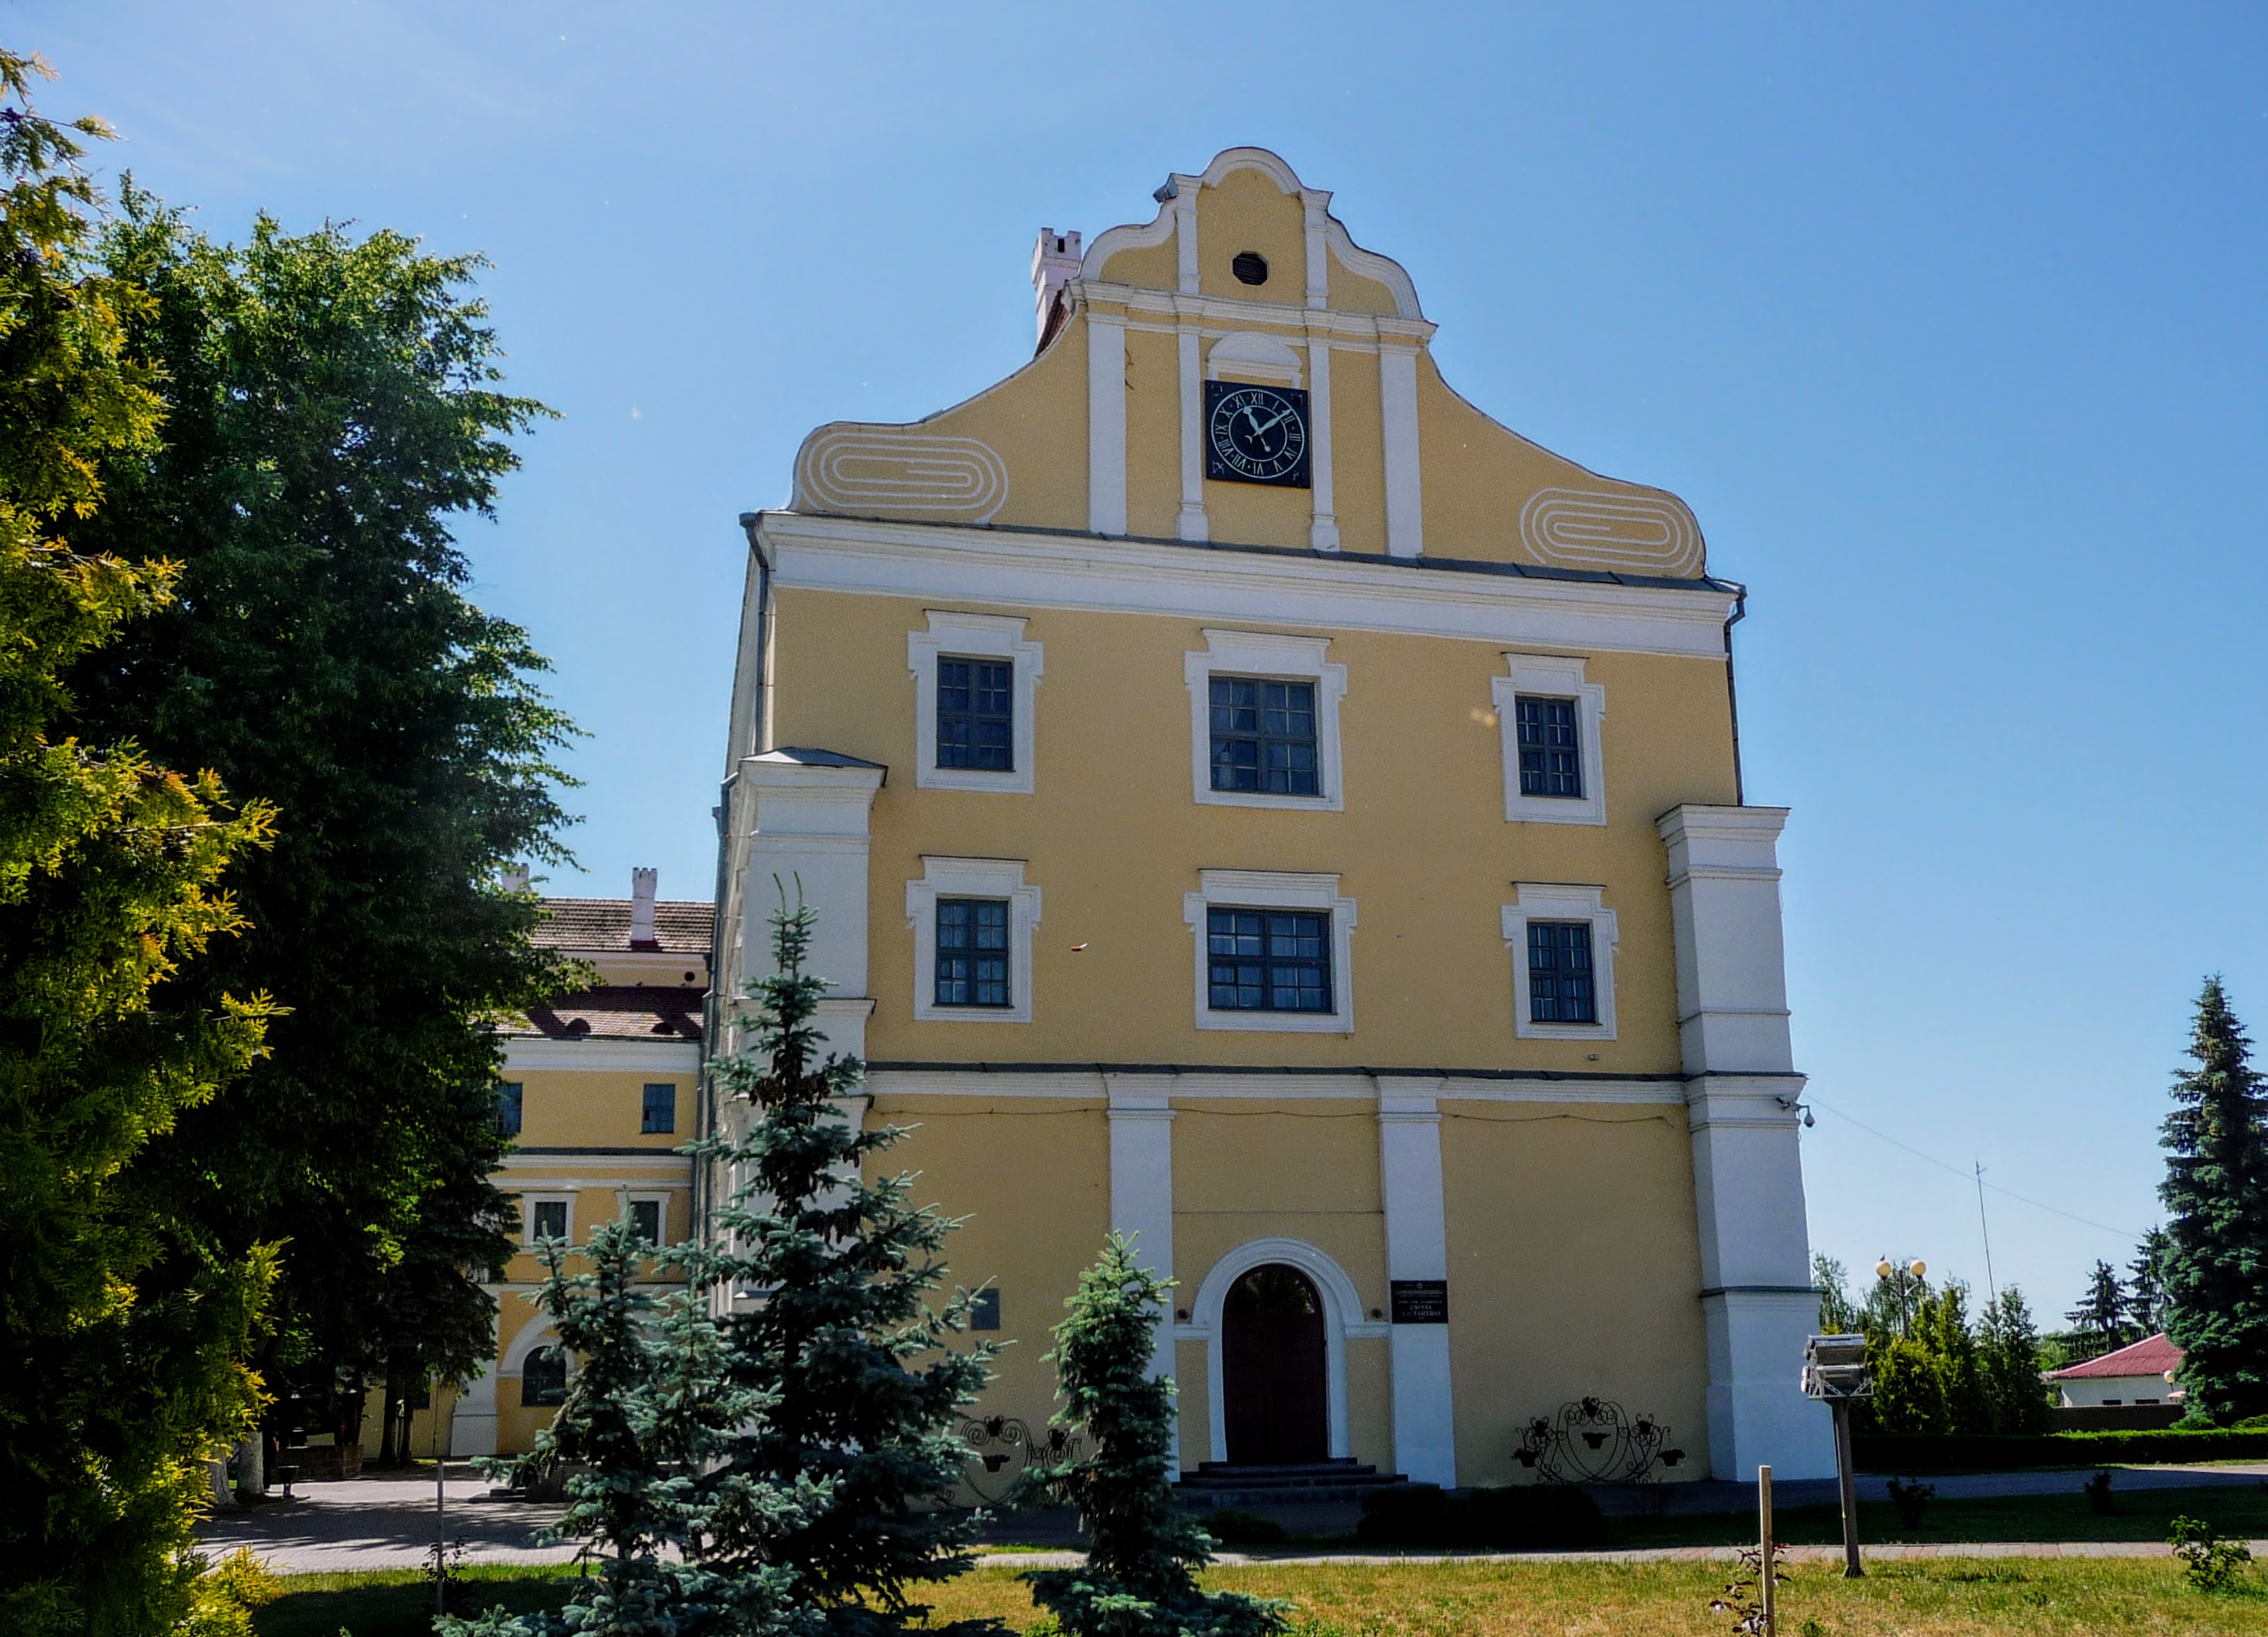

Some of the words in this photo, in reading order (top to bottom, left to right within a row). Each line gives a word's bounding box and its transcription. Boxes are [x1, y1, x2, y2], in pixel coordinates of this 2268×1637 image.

[1251, 392, 1263, 405] XII
[1273, 401, 1280, 411] I
[1219, 408, 1233, 418] X
[1215, 424, 1228, 435] IX
[1289, 433, 1301, 442] III
[1232, 454, 1246, 469] VII
[1273, 459, 1283, 473] V
[1253, 463, 1264, 475] VI
